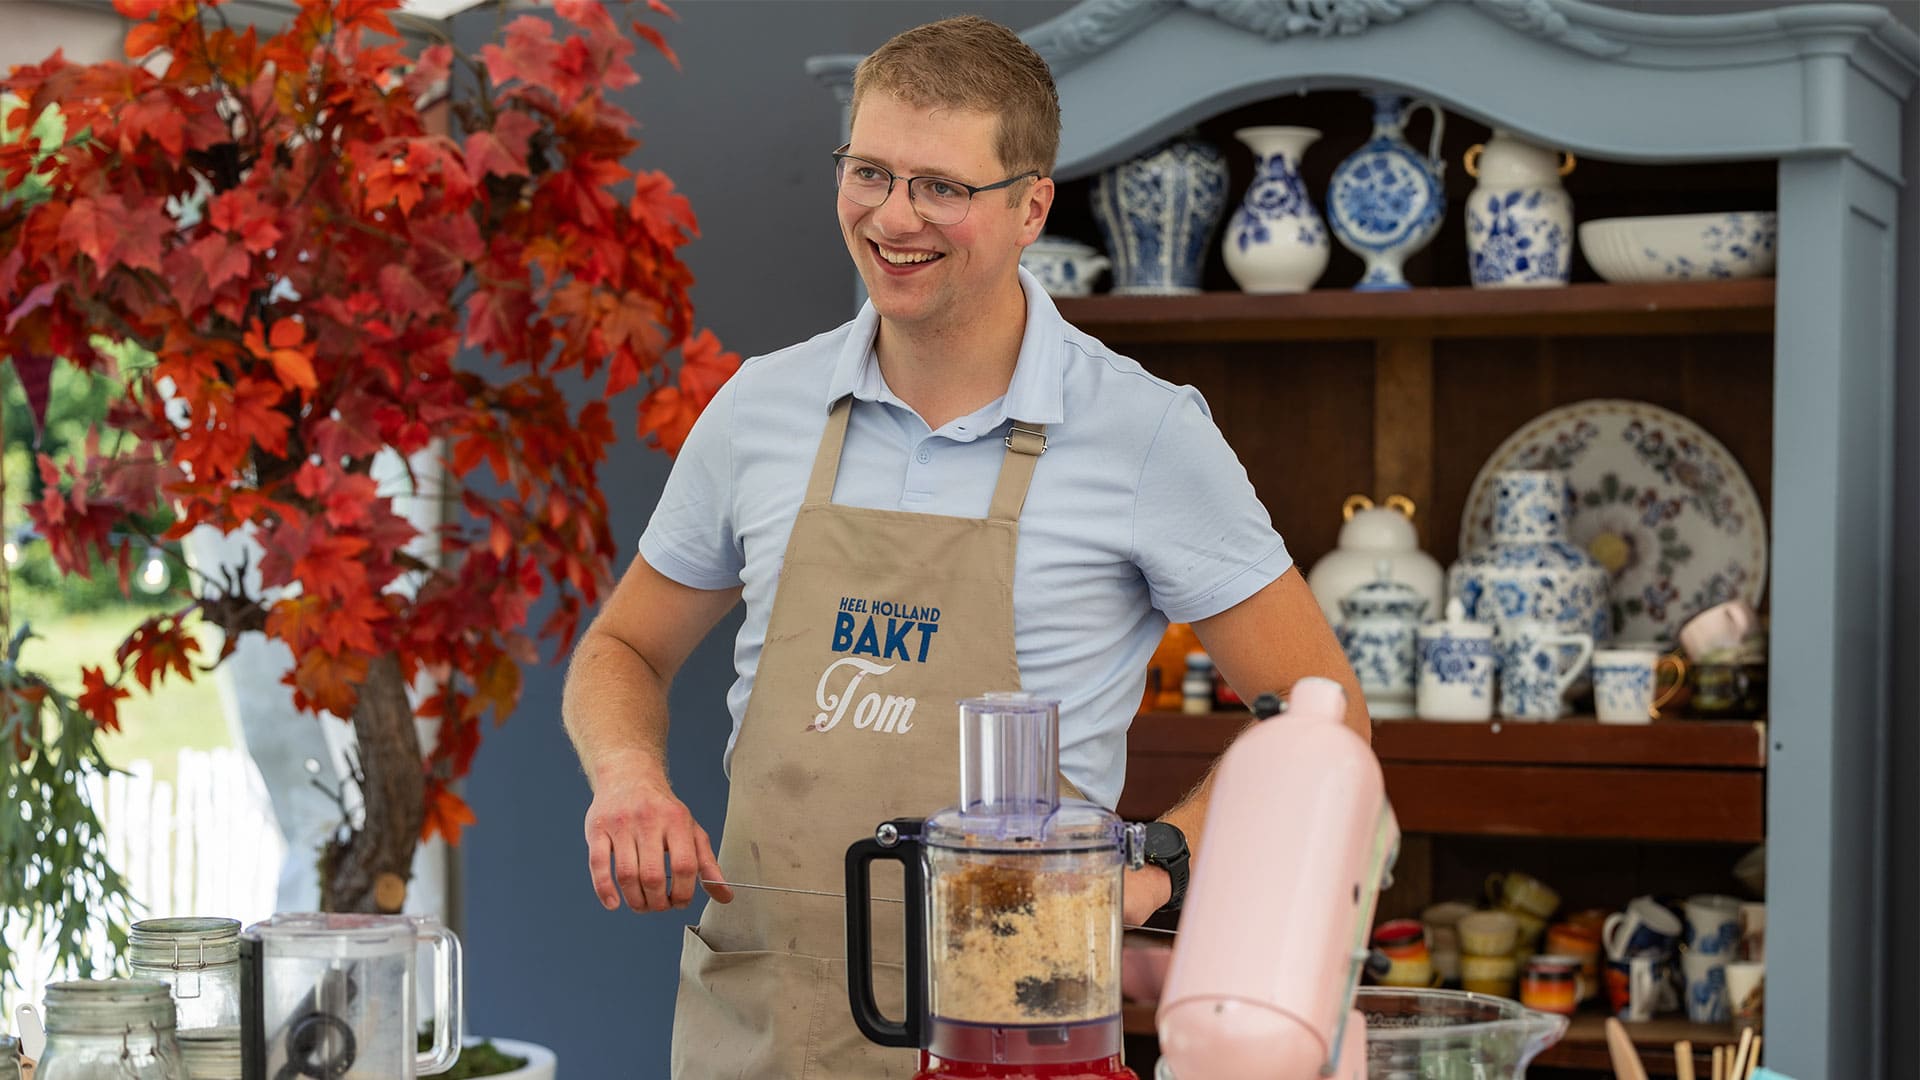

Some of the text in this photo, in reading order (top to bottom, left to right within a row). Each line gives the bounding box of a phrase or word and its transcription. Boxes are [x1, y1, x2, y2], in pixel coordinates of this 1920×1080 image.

[839, 597, 941, 622] HEEL HOLLAND
[832, 611, 938, 663] BAKT
[815, 657, 916, 734] Tom
